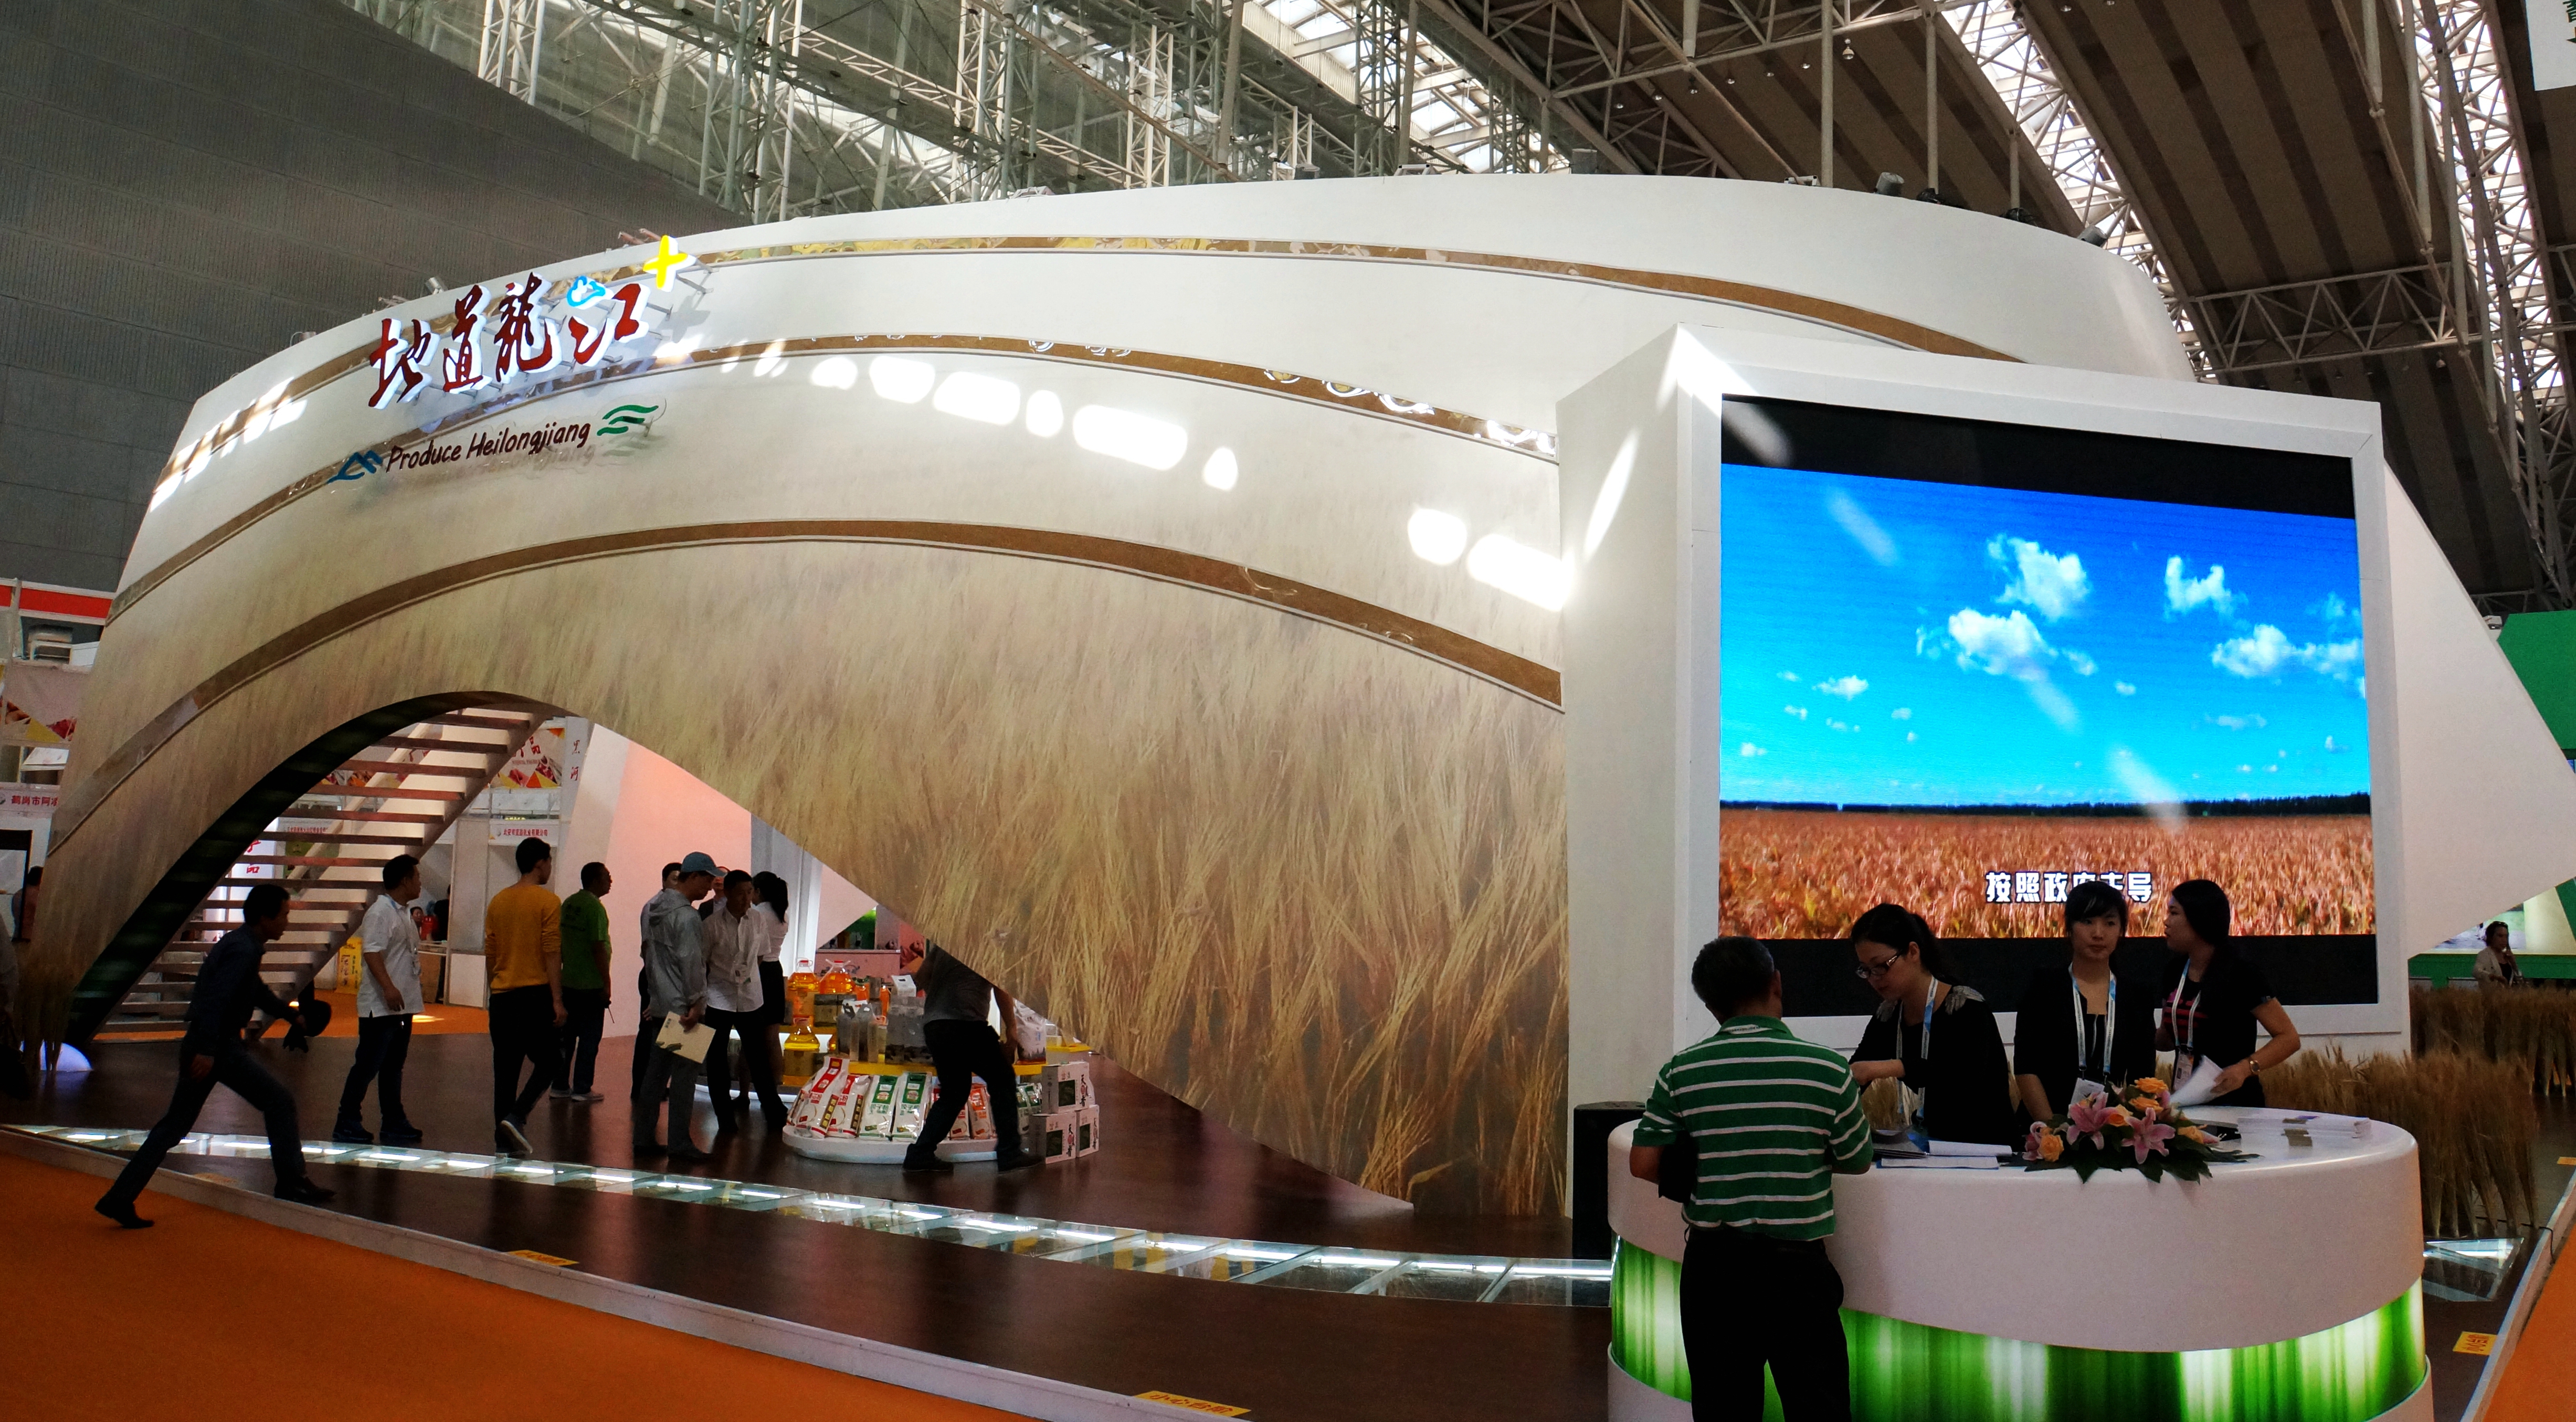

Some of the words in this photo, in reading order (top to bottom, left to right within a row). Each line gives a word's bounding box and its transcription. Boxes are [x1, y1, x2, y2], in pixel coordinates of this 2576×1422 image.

[386, 440, 461, 472] Produce
[467, 421, 591, 455] Heilongjiang
[1149, 1394, 1233, 1414] 小心台阶
